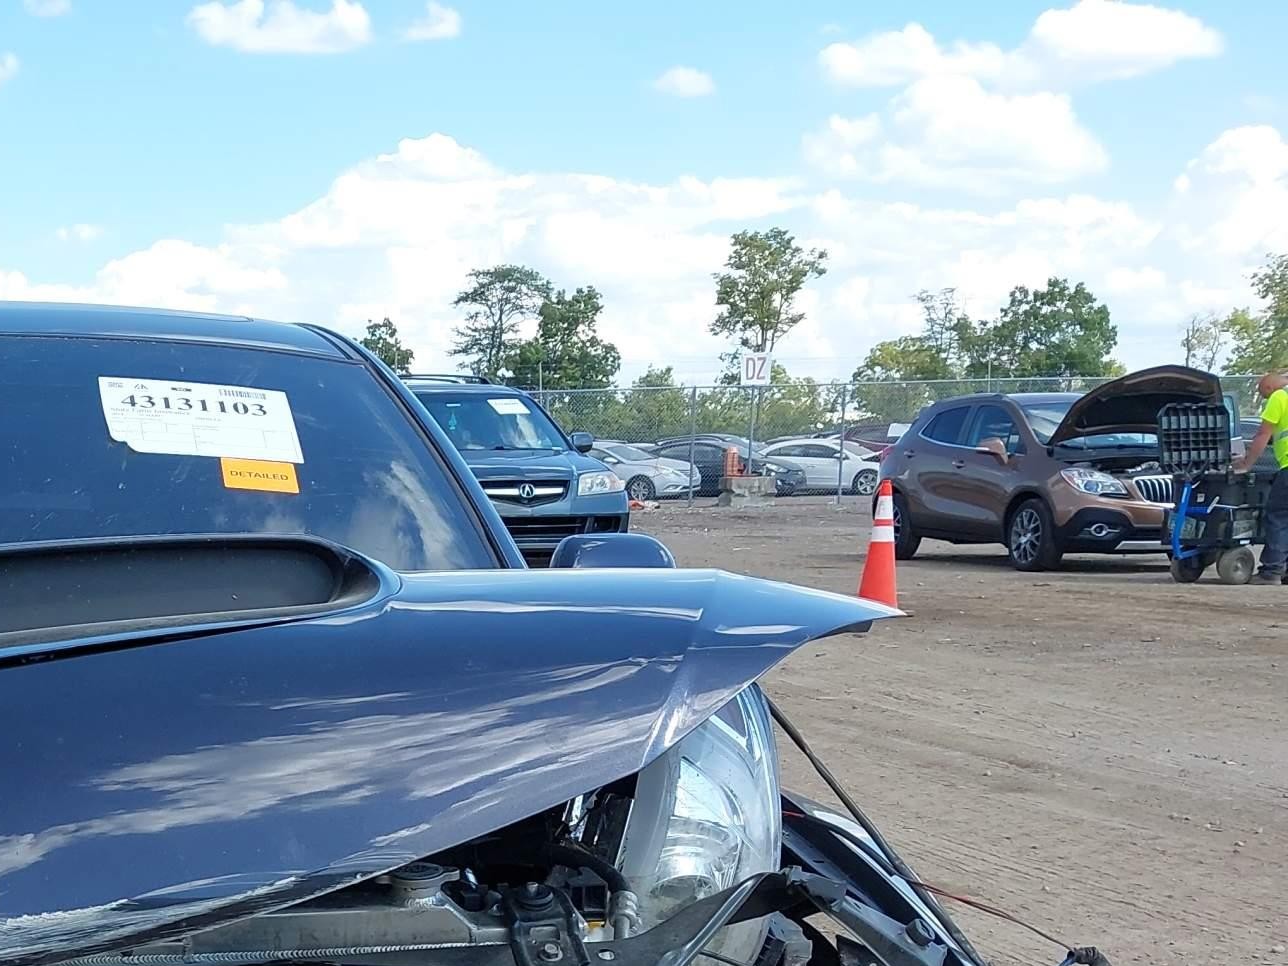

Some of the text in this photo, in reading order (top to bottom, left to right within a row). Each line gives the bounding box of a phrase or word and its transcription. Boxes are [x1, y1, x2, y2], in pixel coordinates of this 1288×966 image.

[746, 357, 767, 380] DZ
[121, 394, 267, 416] 43131103
[230, 470, 289, 481] DETAILED
